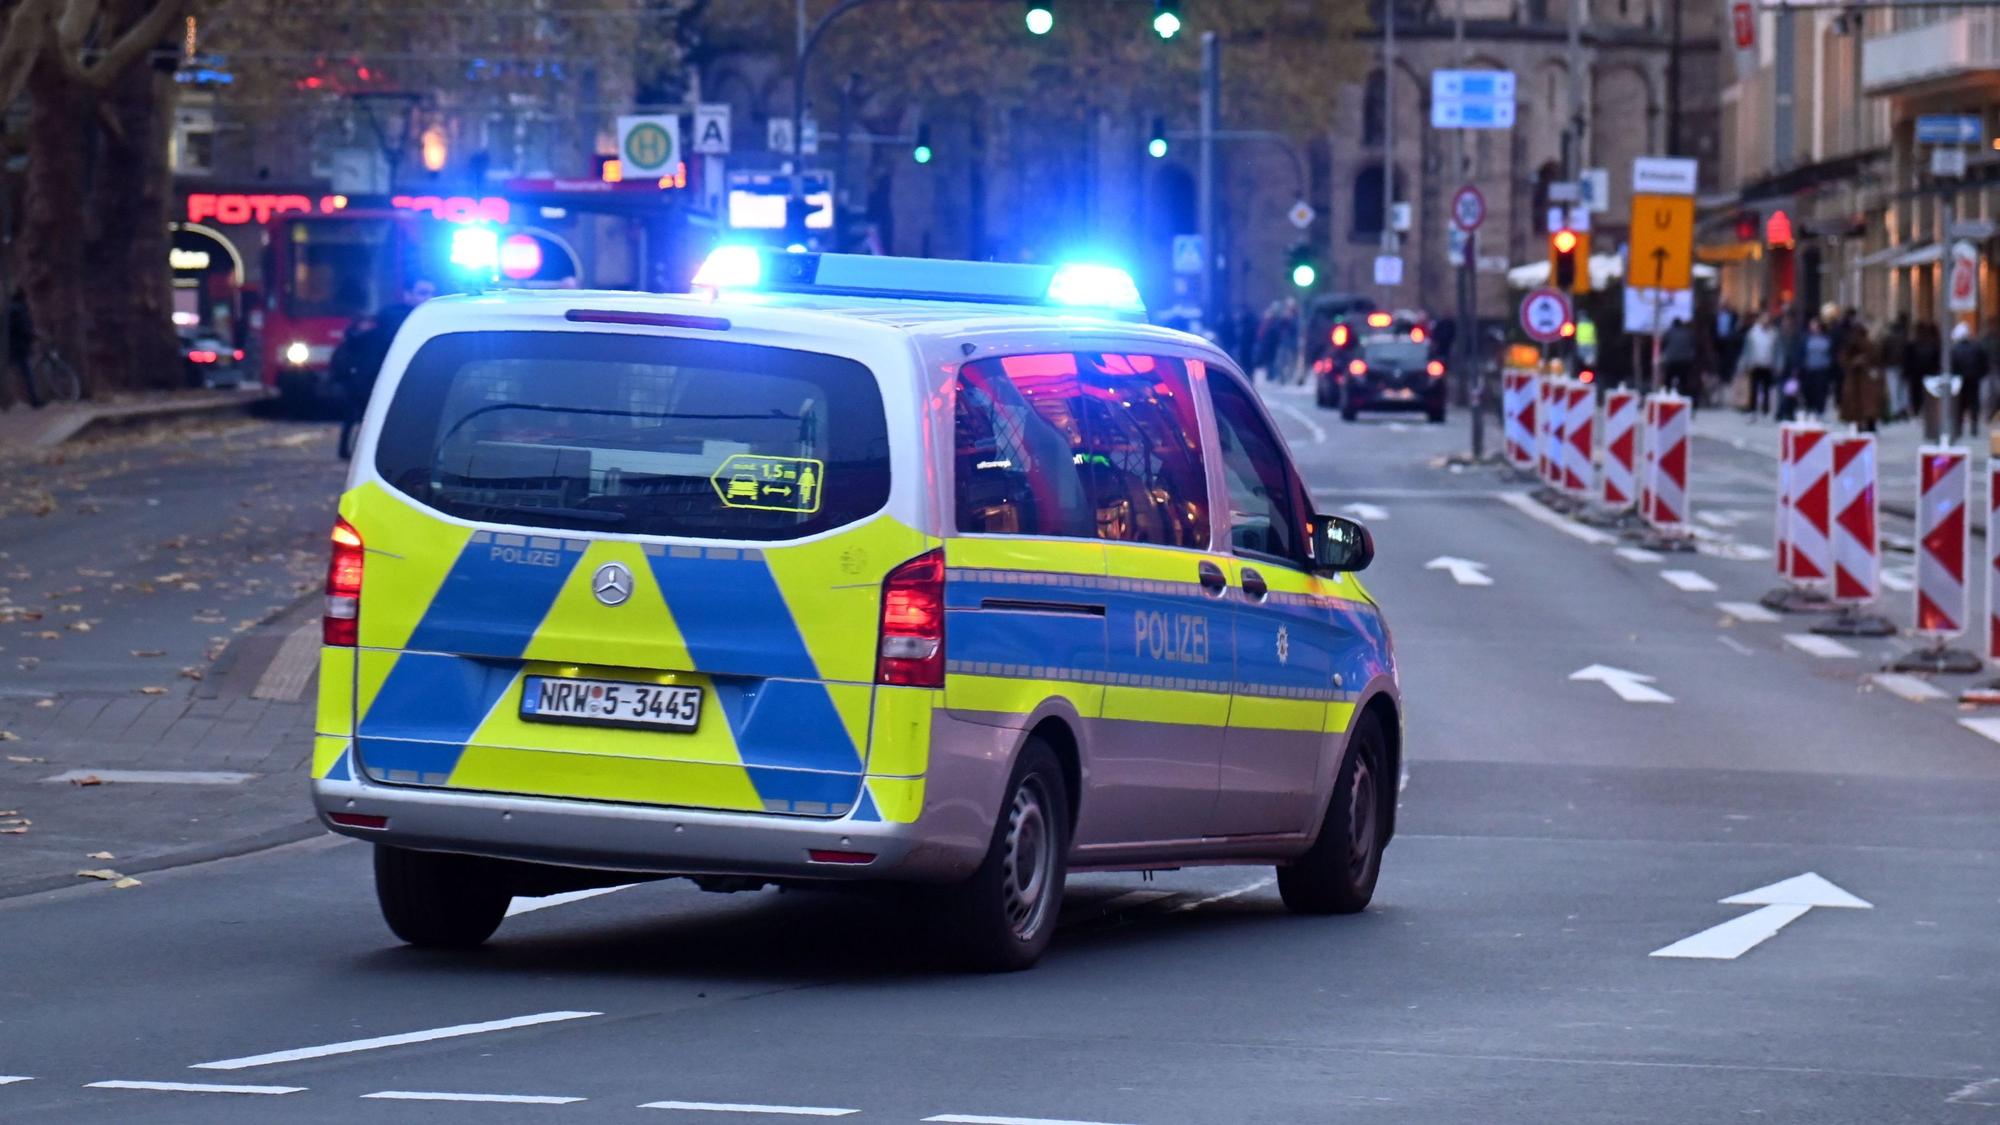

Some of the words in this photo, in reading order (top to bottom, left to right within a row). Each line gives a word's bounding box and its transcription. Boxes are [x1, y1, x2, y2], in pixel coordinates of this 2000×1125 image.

[703, 119, 723, 144] A
[1654, 208, 1673, 231] U
[761, 464, 784, 479] 1,5
[490, 546, 560, 568] POLIZEI
[1135, 609, 1209, 665] POLIZEI
[539, 682, 590, 713] NRW
[602, 685, 698, 721] 5-3445
